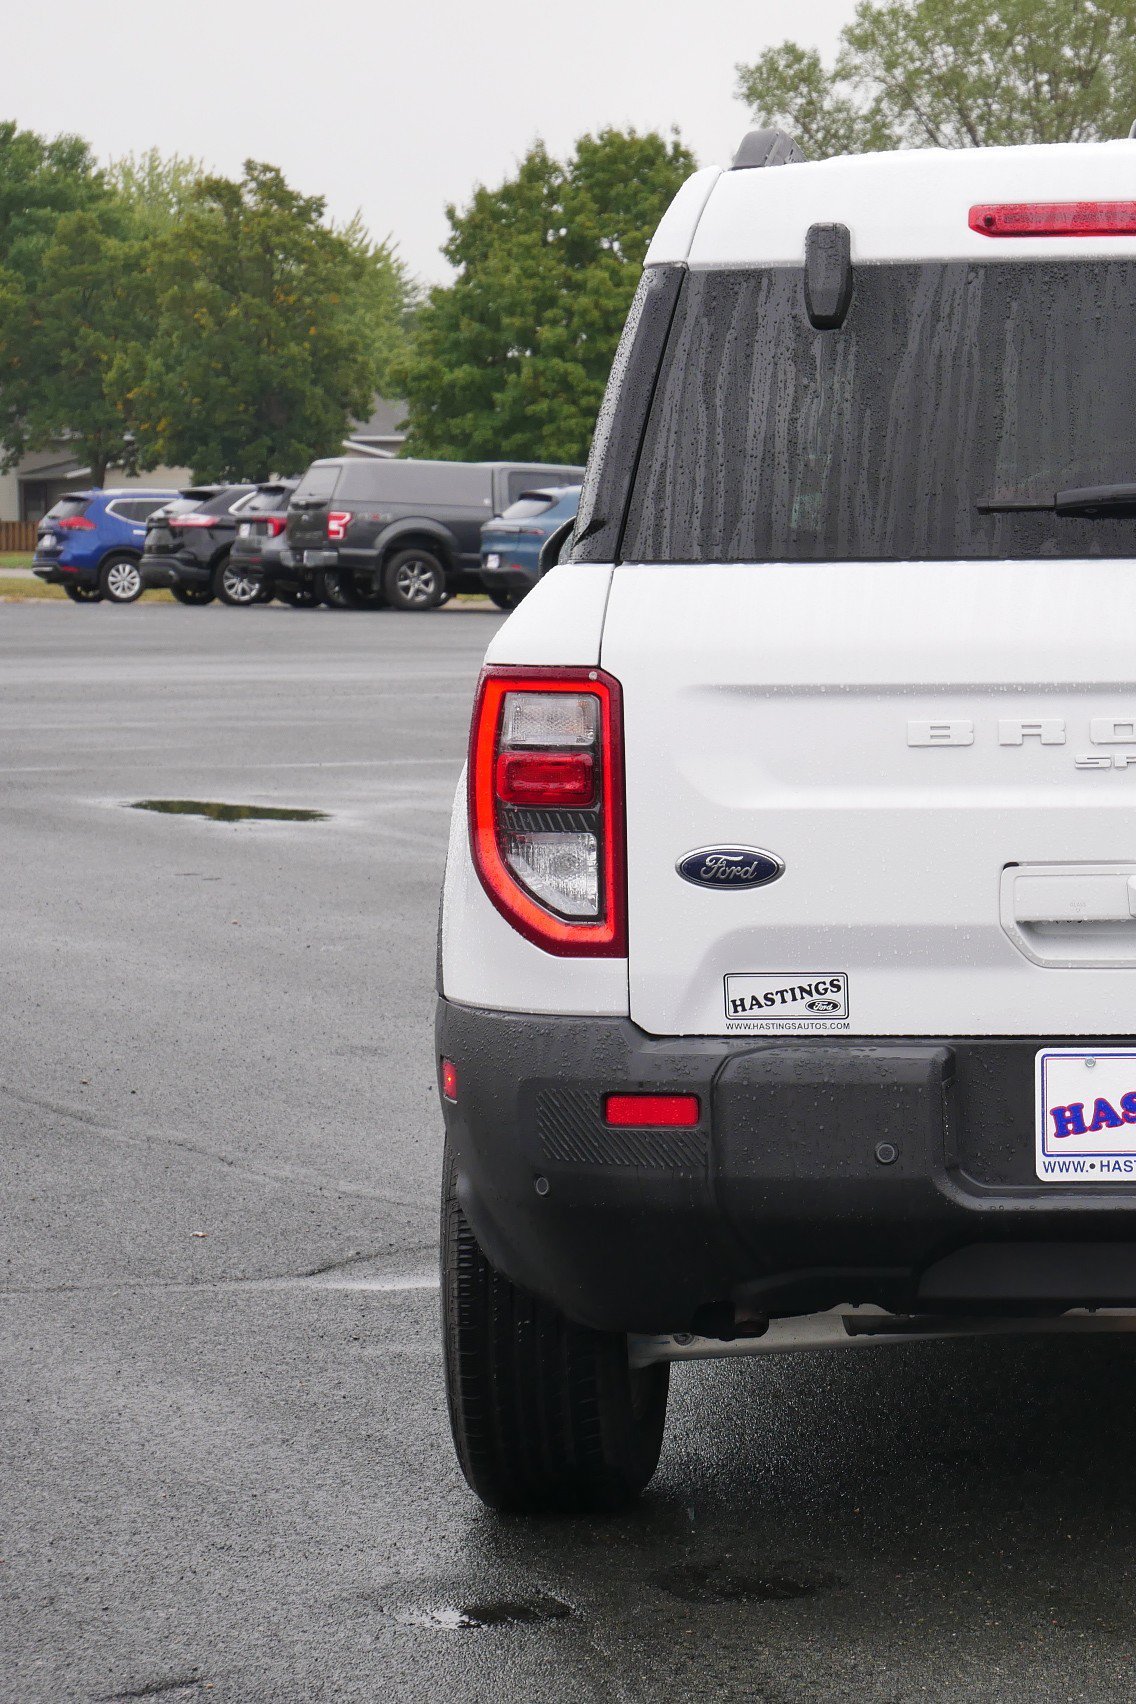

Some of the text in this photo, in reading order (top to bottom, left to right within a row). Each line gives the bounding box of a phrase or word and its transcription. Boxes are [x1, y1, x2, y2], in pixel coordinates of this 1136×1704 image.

[700, 854, 758, 880] Ford
[730, 978, 842, 1013] HASTINGS
[725, 1022, 851, 1030] WWW.HASTINGSAUTOS.COM
